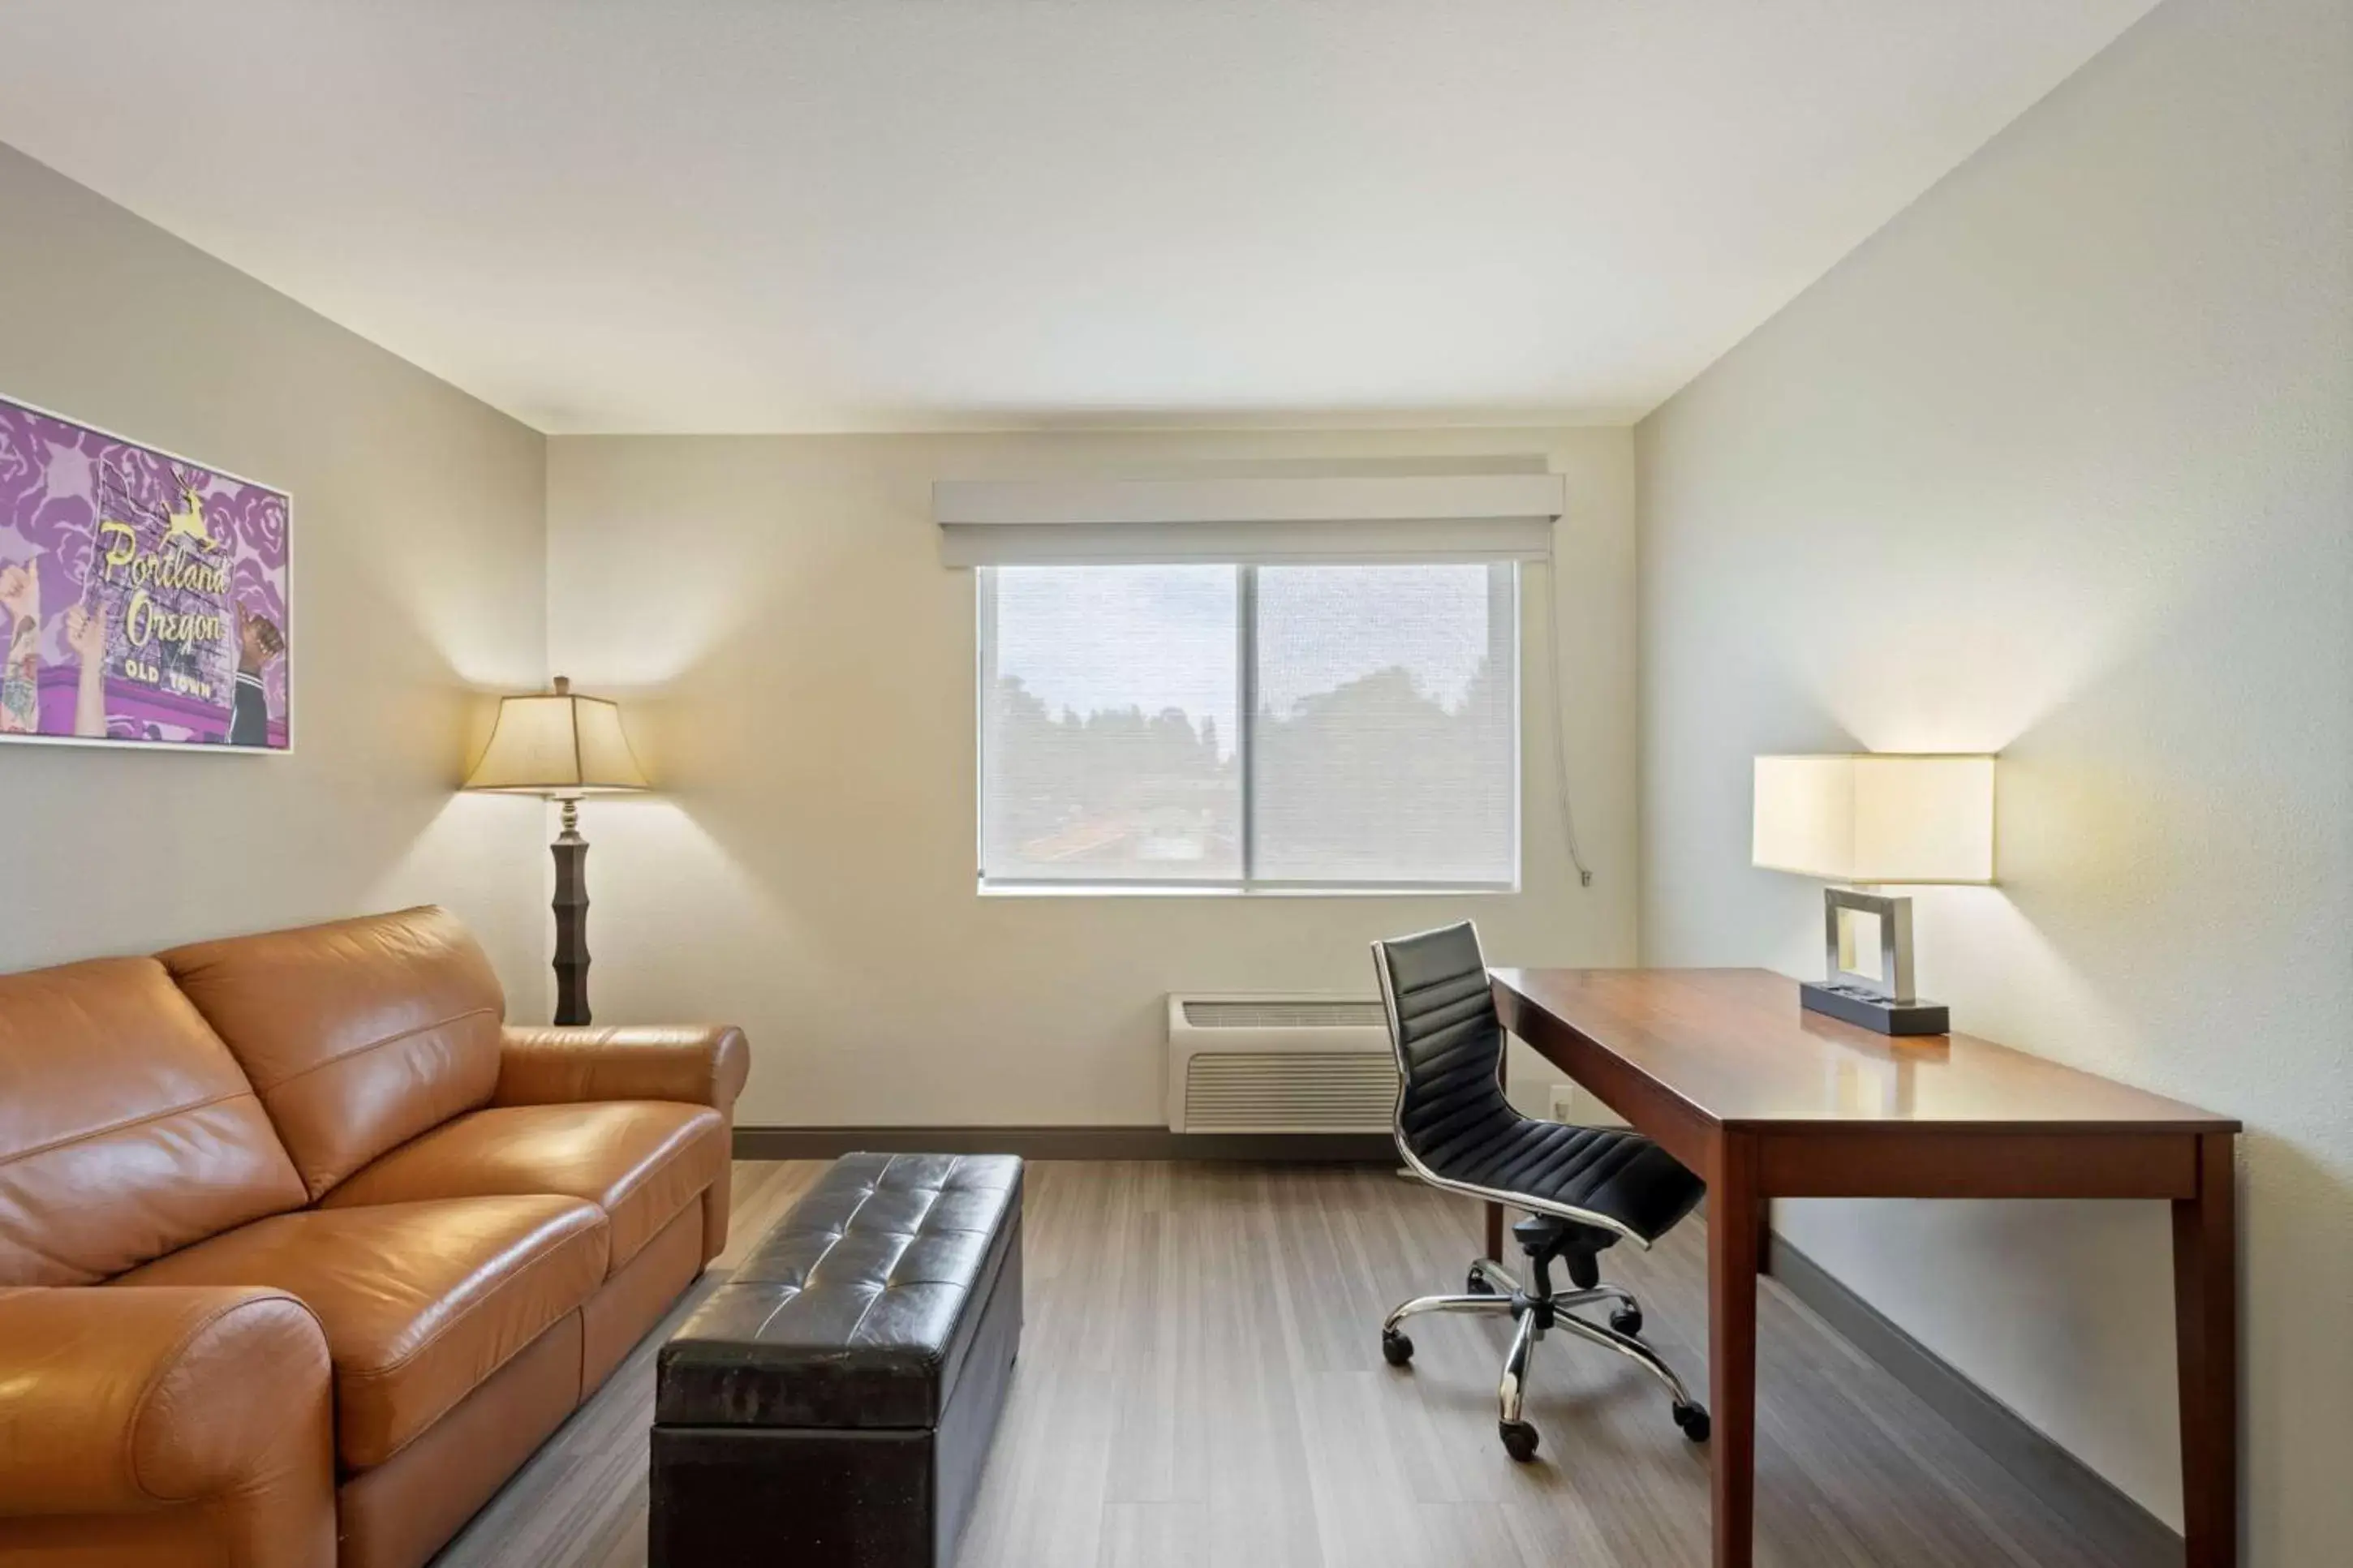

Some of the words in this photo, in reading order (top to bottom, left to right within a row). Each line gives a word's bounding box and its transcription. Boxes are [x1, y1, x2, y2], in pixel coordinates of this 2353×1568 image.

[100, 521, 230, 595] Portland
[127, 590, 222, 655] Oregon
[124, 659, 160, 682] OLD
[170, 672, 211, 698] TOWN
